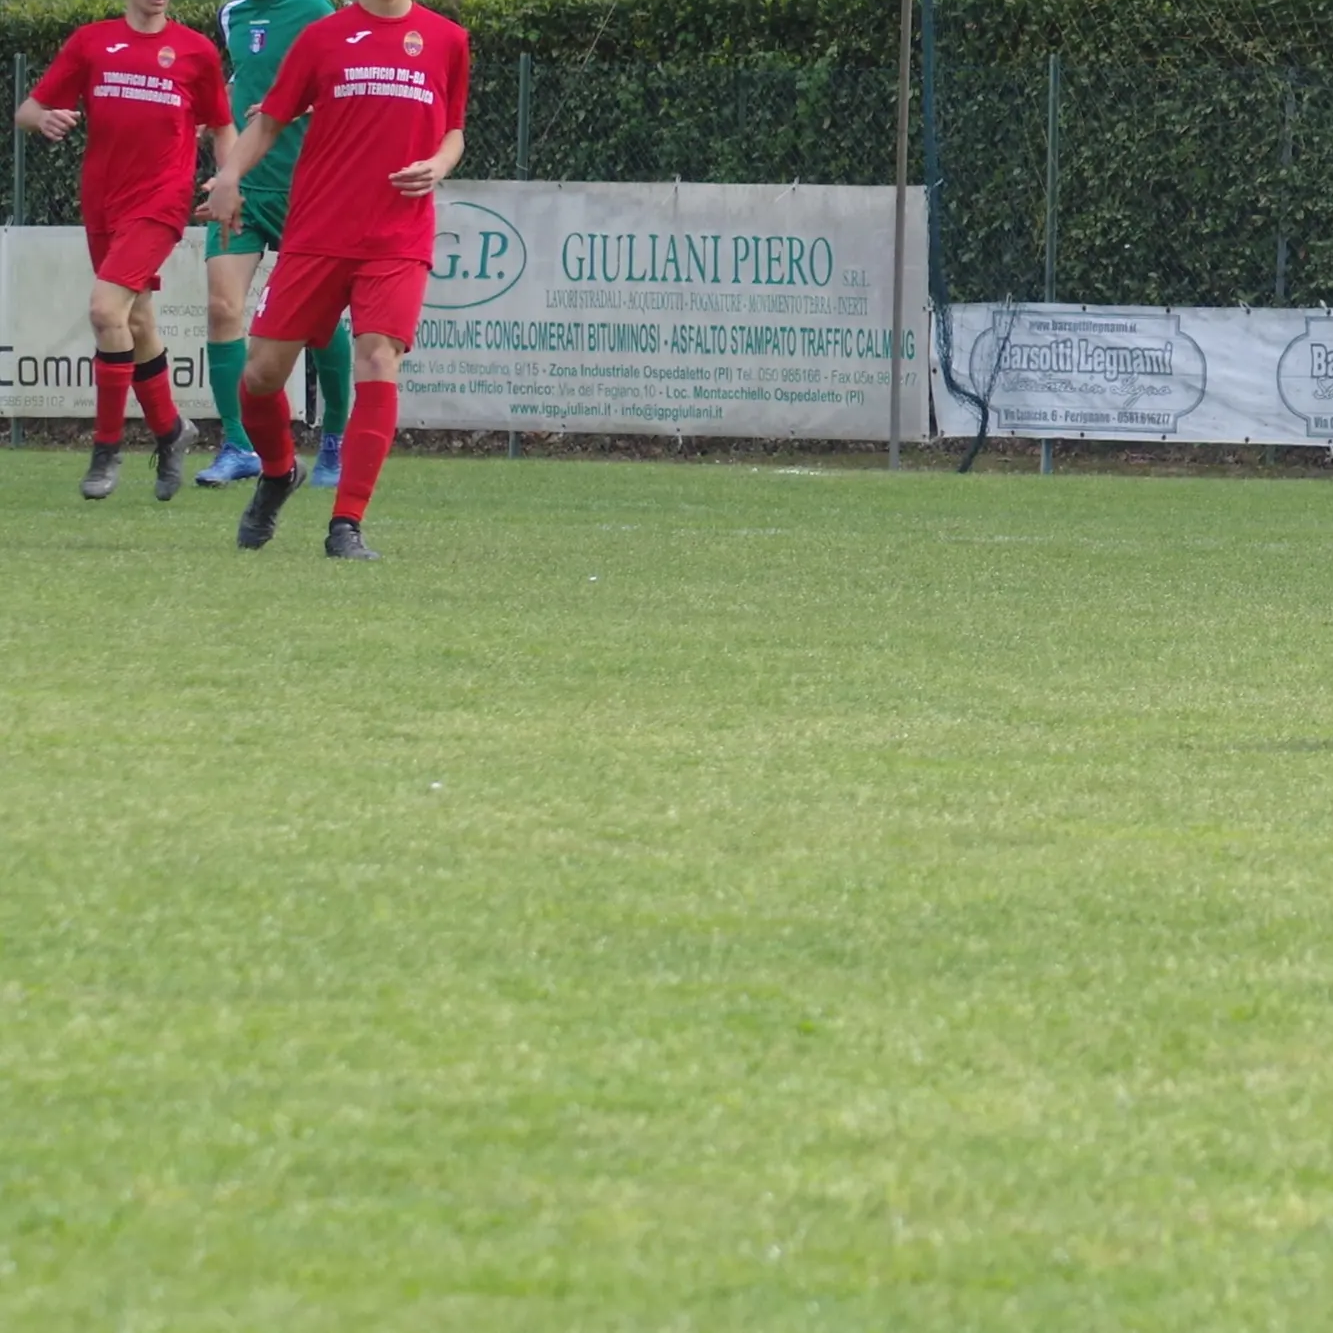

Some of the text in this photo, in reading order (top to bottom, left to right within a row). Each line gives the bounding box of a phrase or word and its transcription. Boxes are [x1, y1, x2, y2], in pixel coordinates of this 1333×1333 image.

[344, 67, 425, 85] TOMAIFICIO MI-BA
[562, 232, 721, 283] GIULIANI
[732, 235, 833, 287] PIERO
[546, 290, 578, 309] LAVORI
[579, 290, 621, 310] STRADALI
[628, 291, 684, 314] ACQUEDOTTI
[690, 292, 742, 312] FOGNATURE
[749, 293, 804, 314] MOVIMENTO
[804, 295, 832, 315] TERRA
[838, 296, 868, 316] INERTI
[486, 320, 584, 351] CONGLOMERATI
[588, 322, 660, 353] BITUMINOSI
[671, 324, 727, 355] ASFALTO
[730, 325, 797, 357] STAMPATO
[800, 327, 852, 358] TRAFFIC
[856, 328, 915, 360] CALMG
[0, 346, 204, 388] Commal
[428, 360, 444, 374] Via
[446, 360, 456, 374] di
[515, 362, 539, 376] 9/15
[549, 364, 577, 377] Zona
[580, 364, 640, 378] Industriale
[643, 366, 711, 381] Ospedaletto
[714, 367, 733, 383] (PI)
[758, 369, 779, 383] 050
[831, 370, 851, 384] Fax
[1000, 337, 1173, 382] Barsotti Legnami
[406, 380, 456, 394] Operativa
[460, 383, 466, 393] e
[469, 380, 503, 394] Ufficio
[507, 381, 555, 396] Tecnico:
[666, 386, 690, 399] Loc.
[694, 386, 771, 402] Montacchiello
[774, 388, 842, 405] Ospedaletto
[845, 390, 865, 407] (PI)
[621, 404, 723, 422] info@igpgiuliani.it
